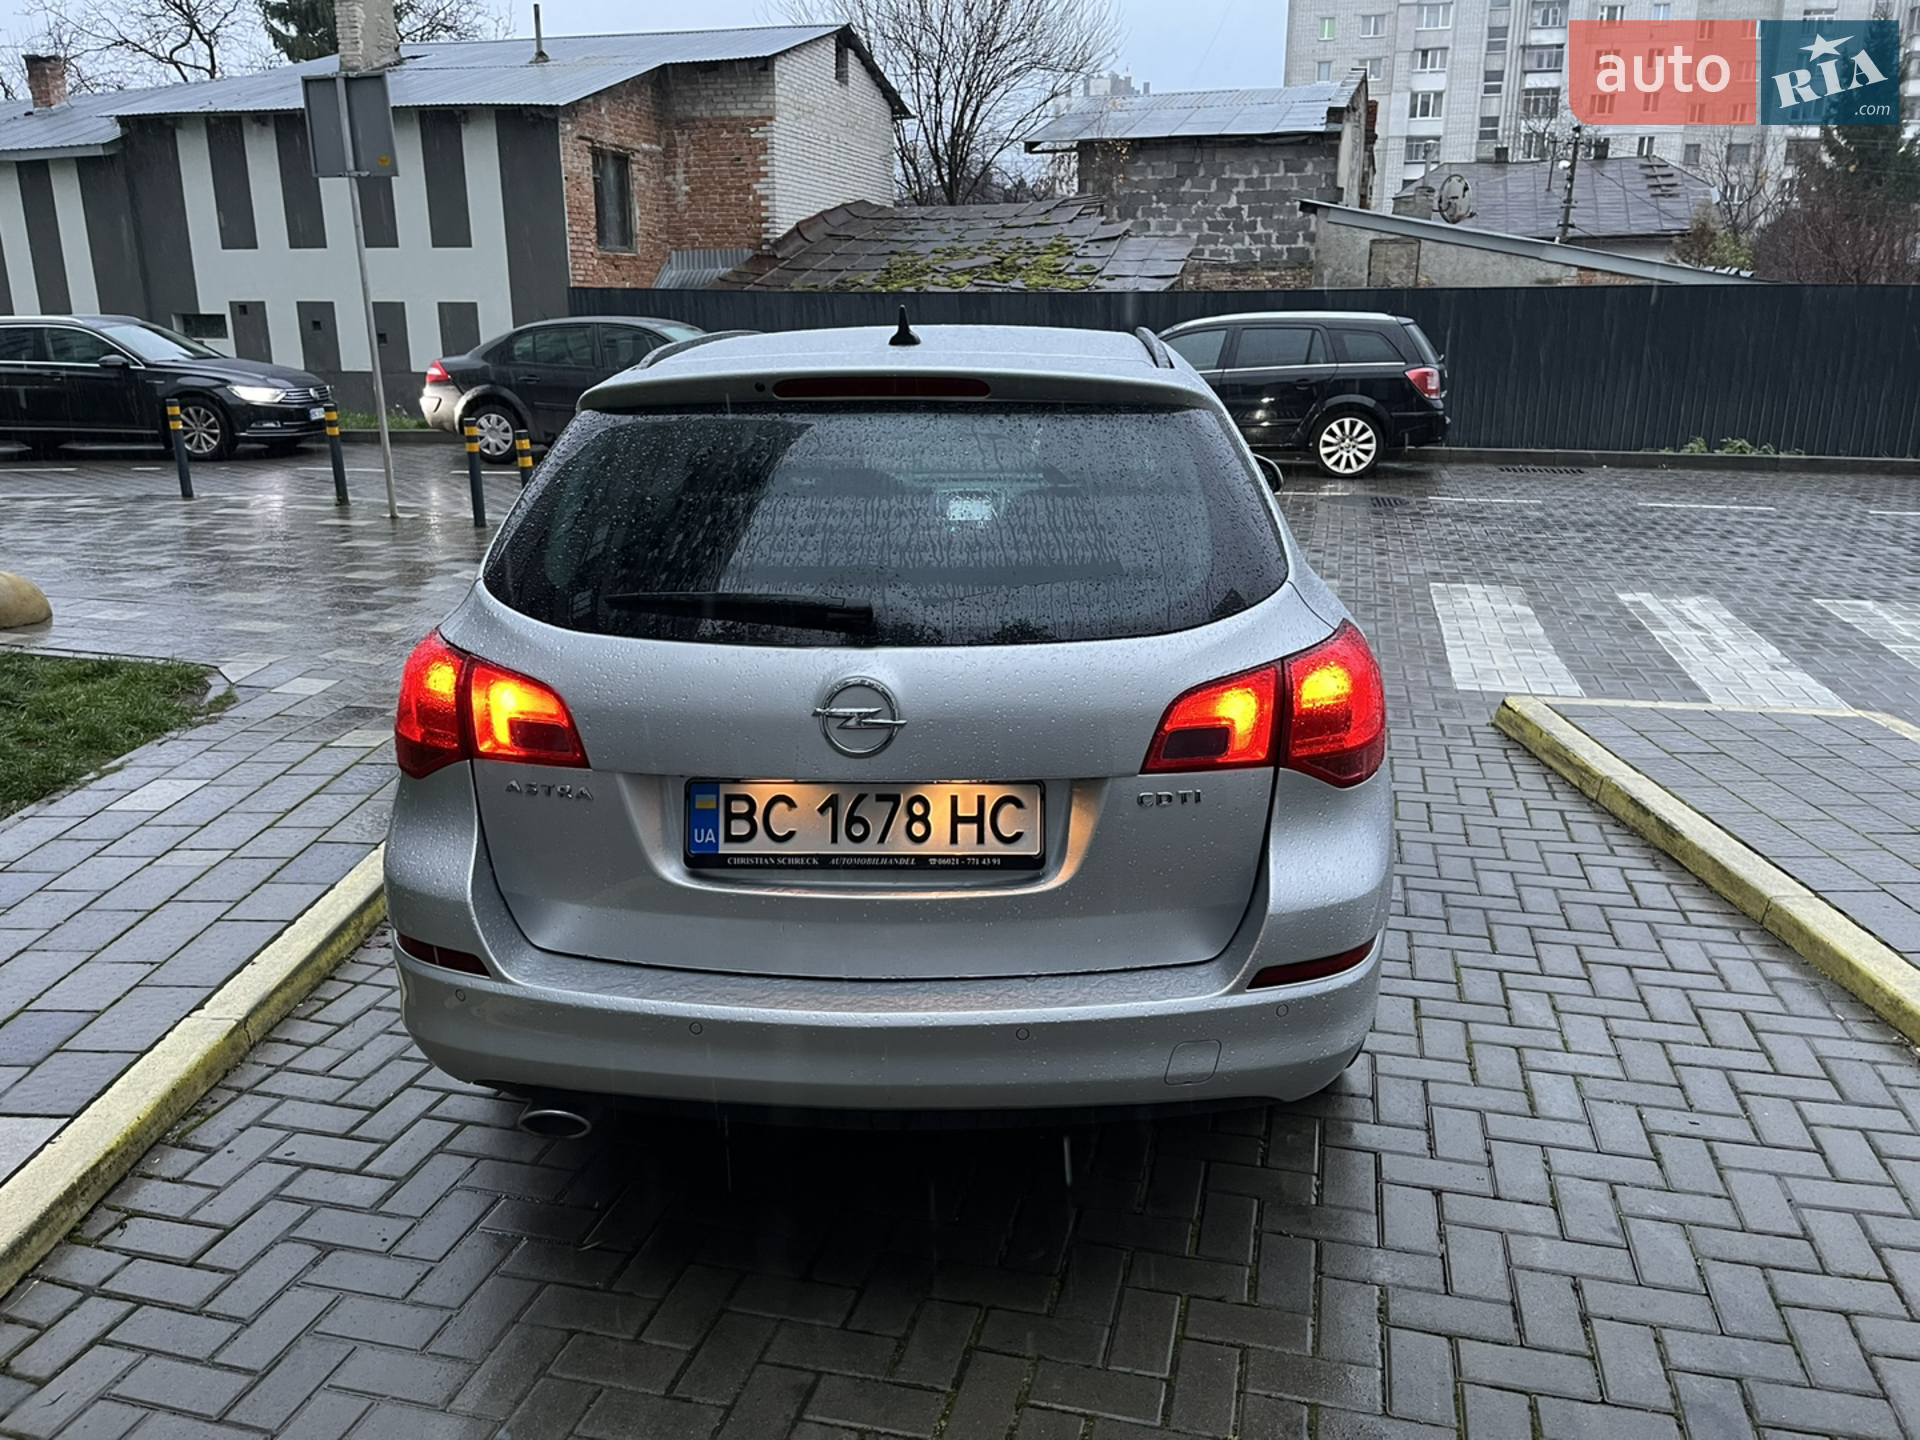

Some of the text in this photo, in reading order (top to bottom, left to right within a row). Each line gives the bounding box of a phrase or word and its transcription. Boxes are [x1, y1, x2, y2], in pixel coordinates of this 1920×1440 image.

[505, 780, 594, 800] ASTRA
[1136, 789, 1201, 807] CDTI
[723, 793, 1027, 844] BC 1678 HC
[694, 828, 716, 844] UA
[727, 857, 775, 865] CHRISTIAN
[776, 857, 819, 865] SCHRECK
[828, 857, 916, 865] AUTOMOBILHANDEL
